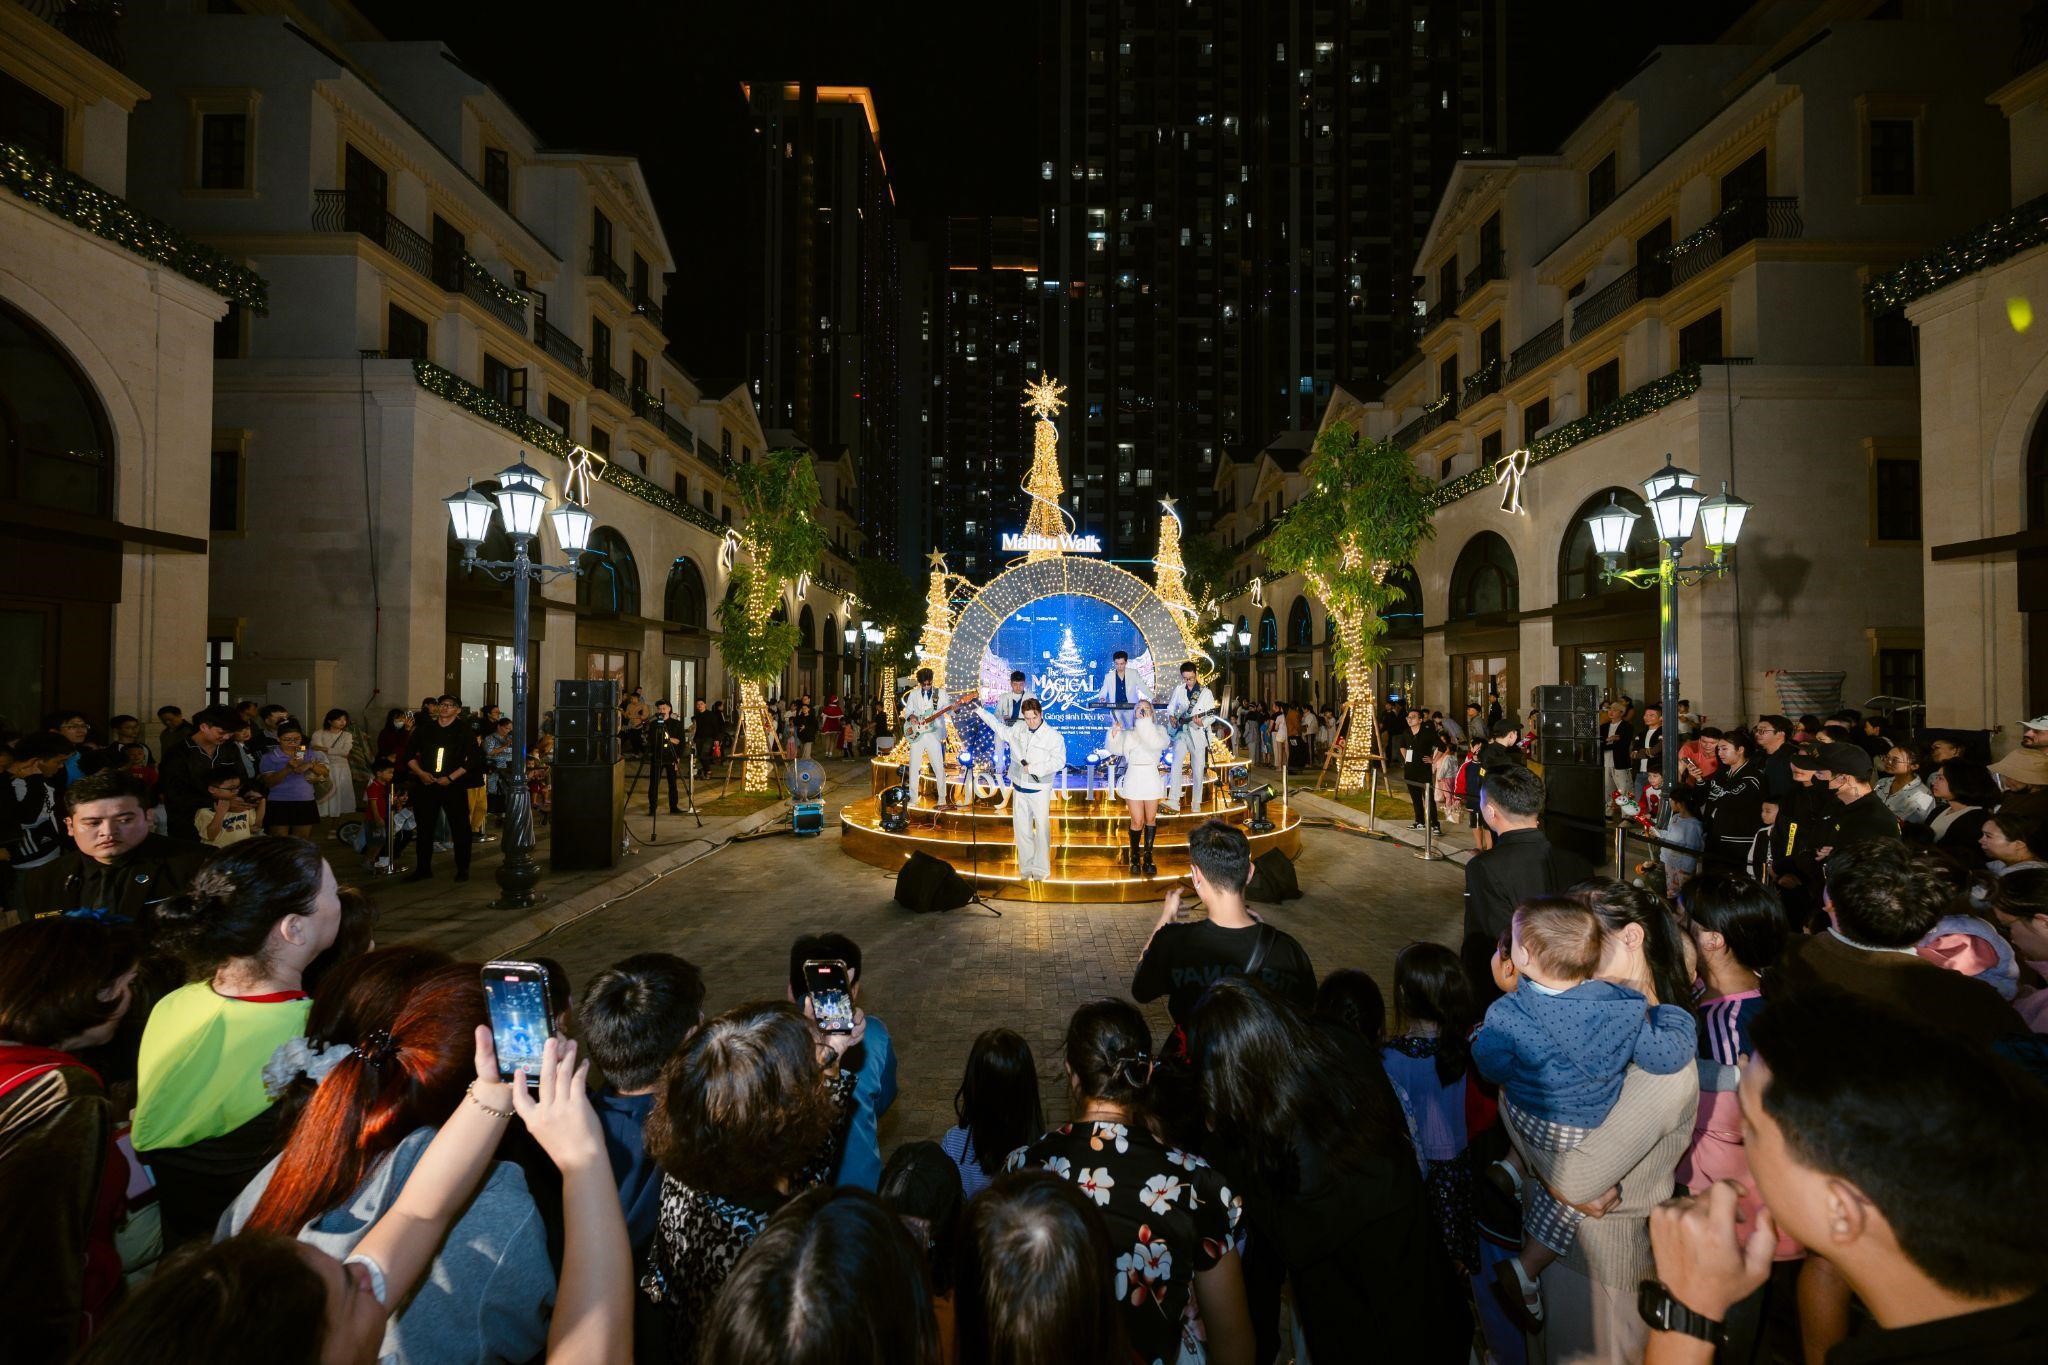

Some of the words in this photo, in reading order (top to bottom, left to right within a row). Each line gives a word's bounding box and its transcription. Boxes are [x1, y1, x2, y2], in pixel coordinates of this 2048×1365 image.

[1002, 533, 1058, 551] Malibu
[1059, 534, 1102, 553] Walk
[1046, 667, 1059, 677] The
